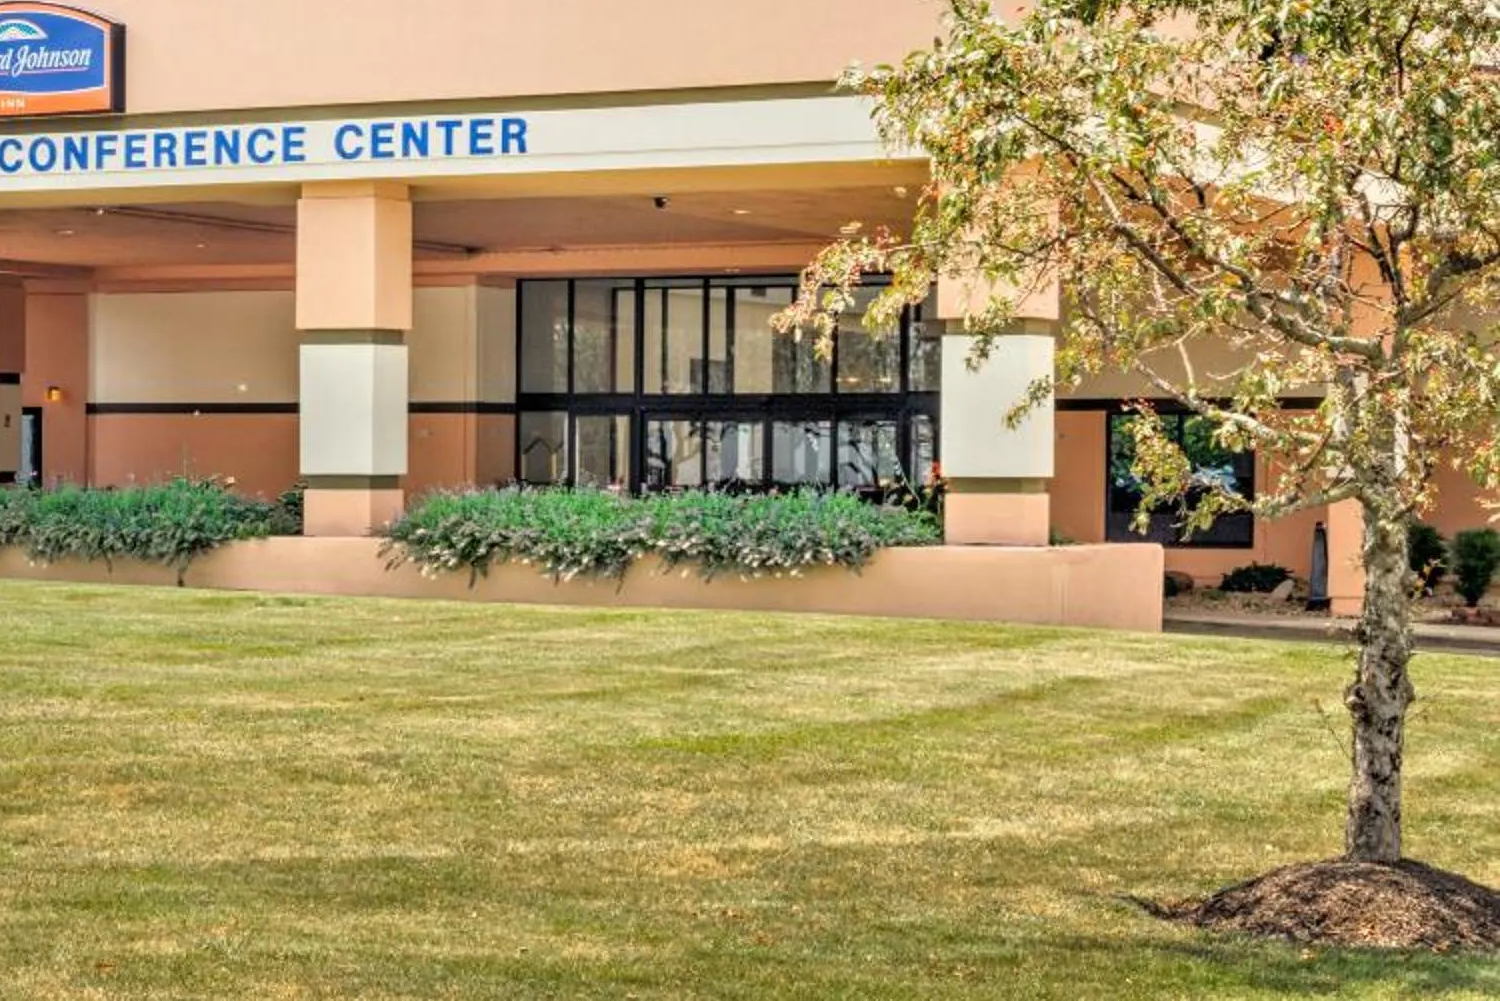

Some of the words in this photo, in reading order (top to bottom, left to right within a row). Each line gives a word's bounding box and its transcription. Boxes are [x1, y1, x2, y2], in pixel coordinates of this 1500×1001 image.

[13, 45, 91, 77] Johnson
[1, 98, 26, 110] INN
[334, 117, 529, 161] CENTER
